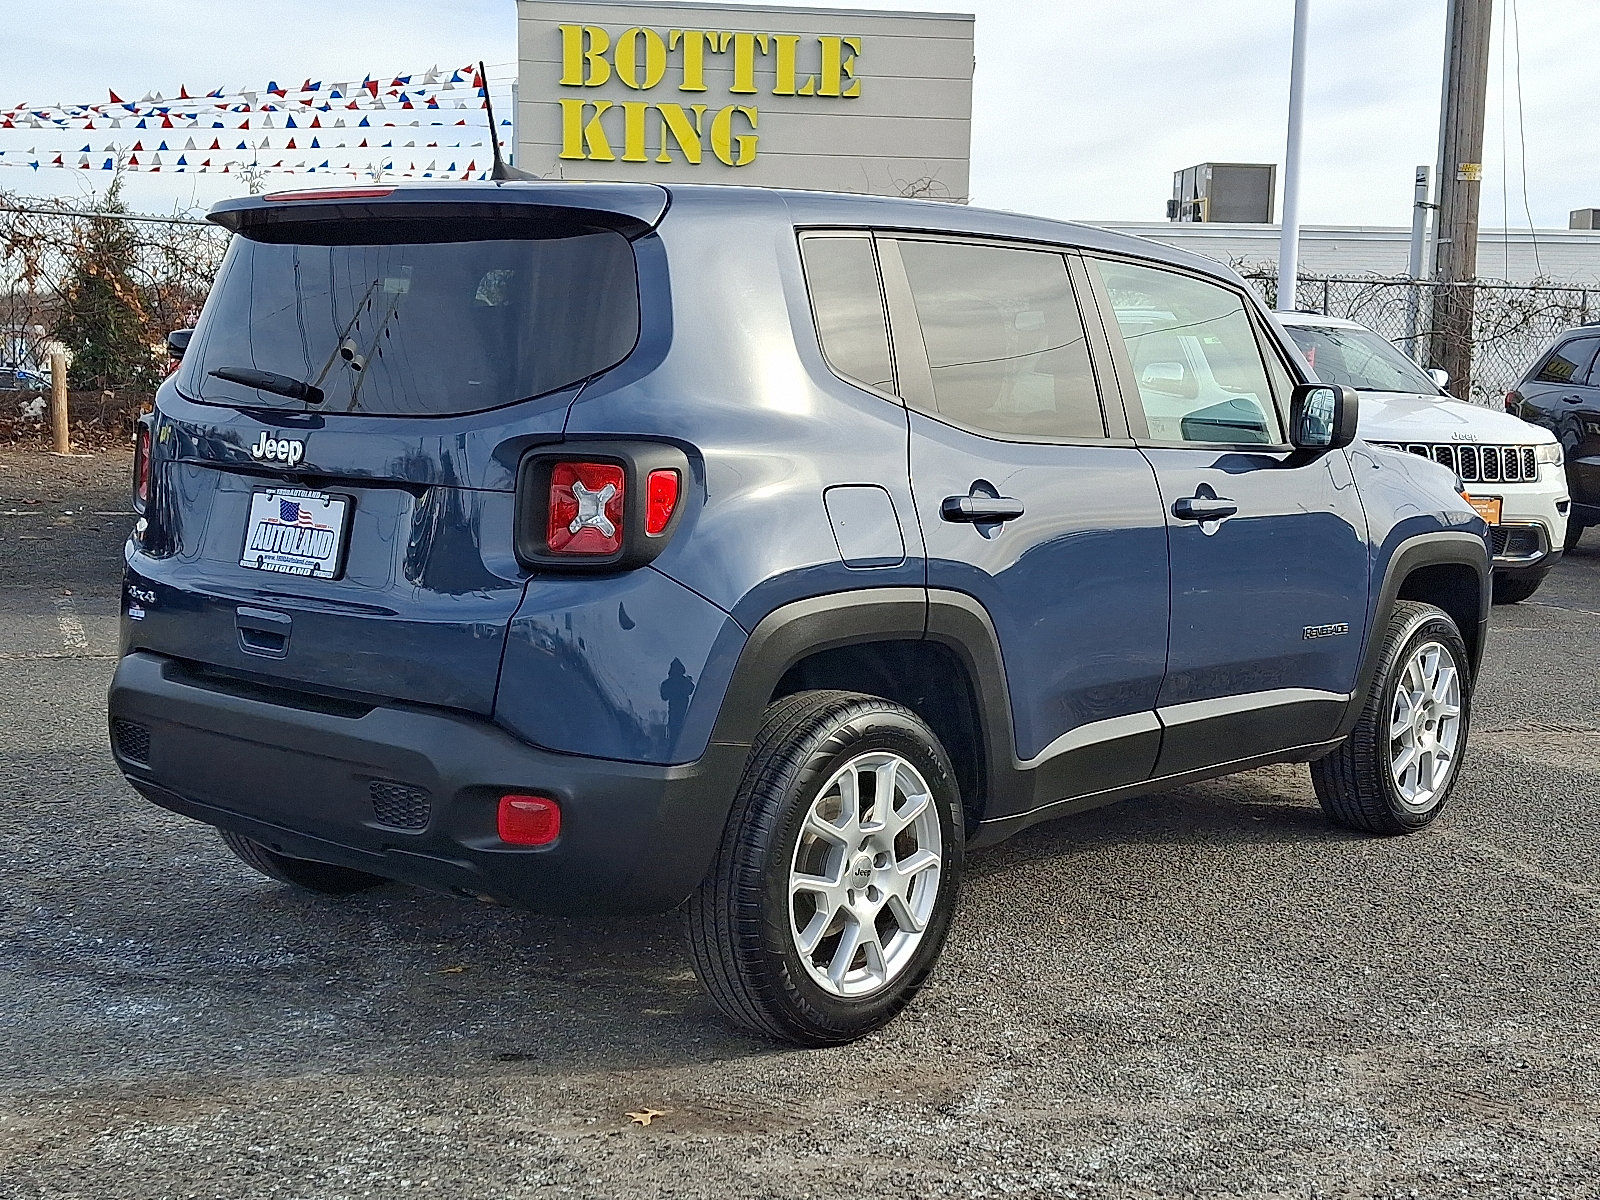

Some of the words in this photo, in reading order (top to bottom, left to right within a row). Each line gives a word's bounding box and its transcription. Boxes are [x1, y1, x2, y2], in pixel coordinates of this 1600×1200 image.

[558, 24, 862, 98] BOTTLE
[558, 97, 760, 167] KING
[252, 430, 303, 467] Jeep
[1451, 431, 1478, 442] Jeep
[250, 521, 335, 560] AUTOLAND
[260, 562, 312, 577] AUTOLAND
[1302, 622, 1350, 640] RENEGADE
[854, 867, 872, 878] Jeep
